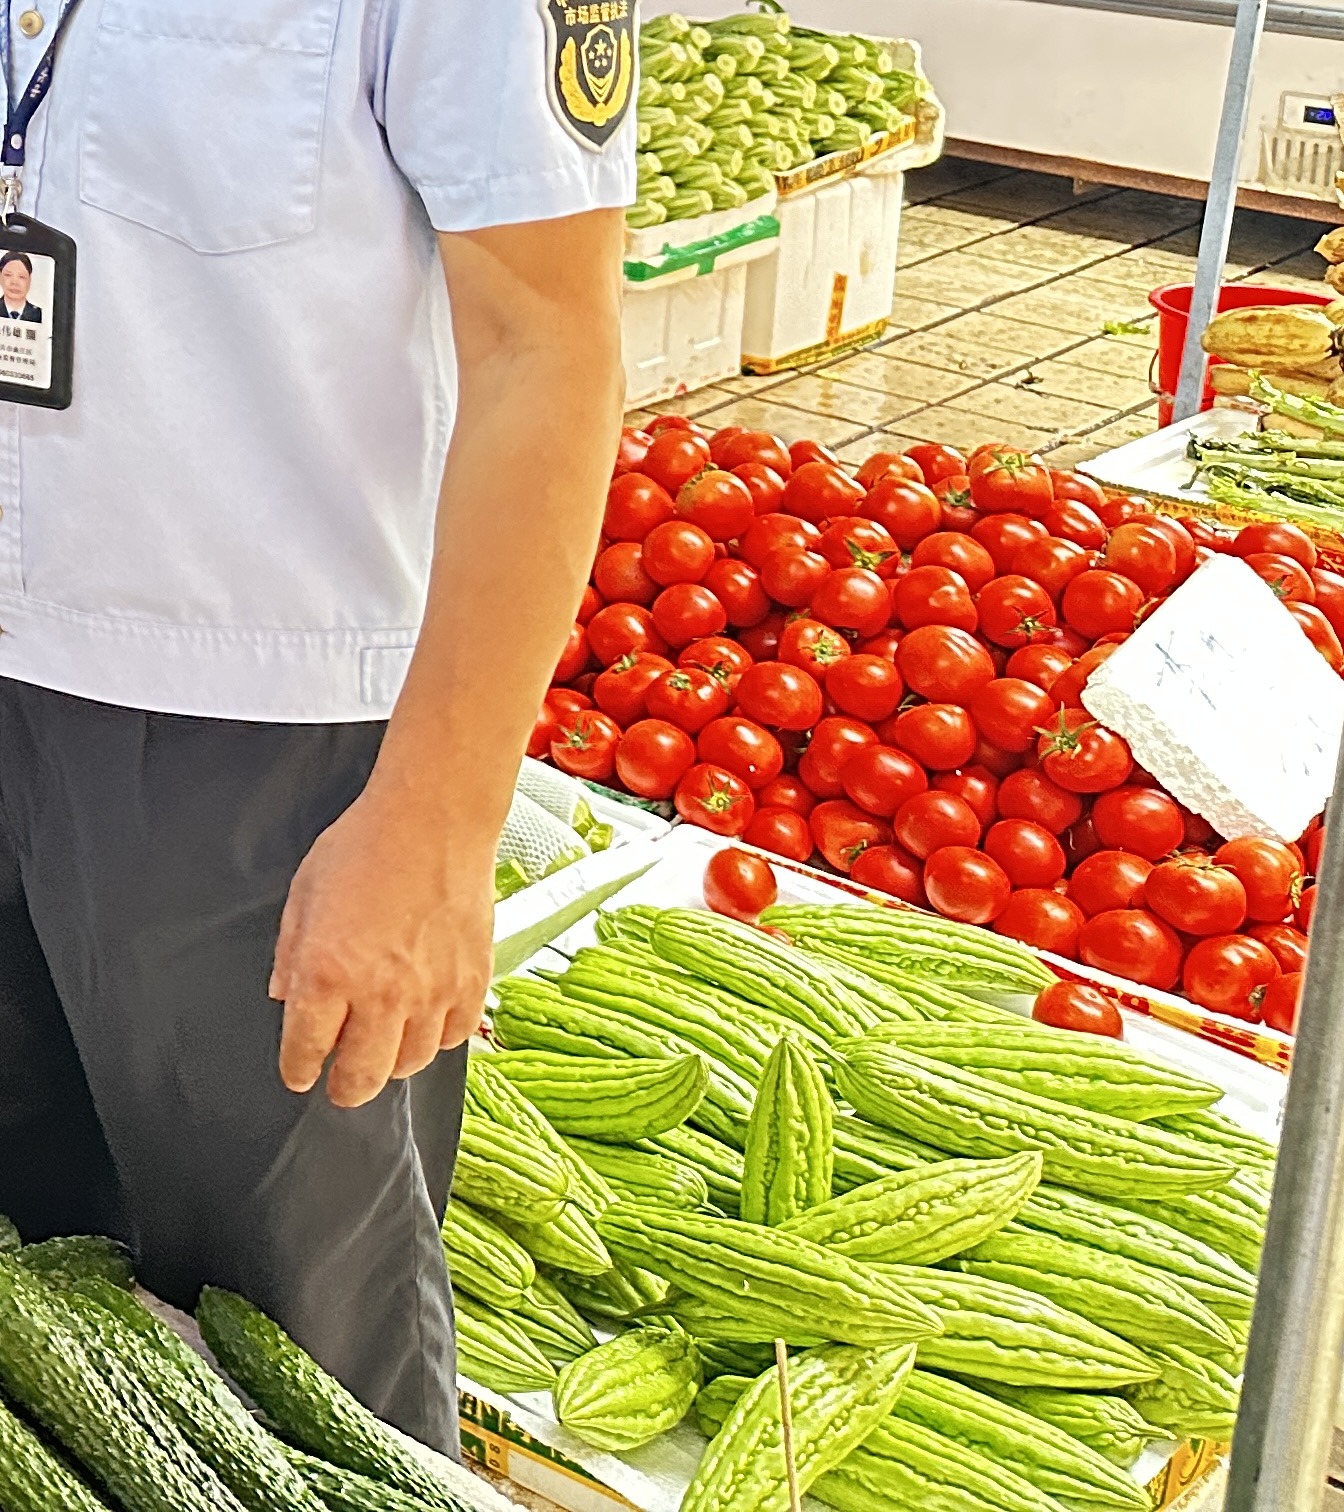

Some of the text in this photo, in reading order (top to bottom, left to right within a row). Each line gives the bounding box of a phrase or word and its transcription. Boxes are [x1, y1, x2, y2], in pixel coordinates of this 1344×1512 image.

[563, 0, 629, 26] 市场监管执法
